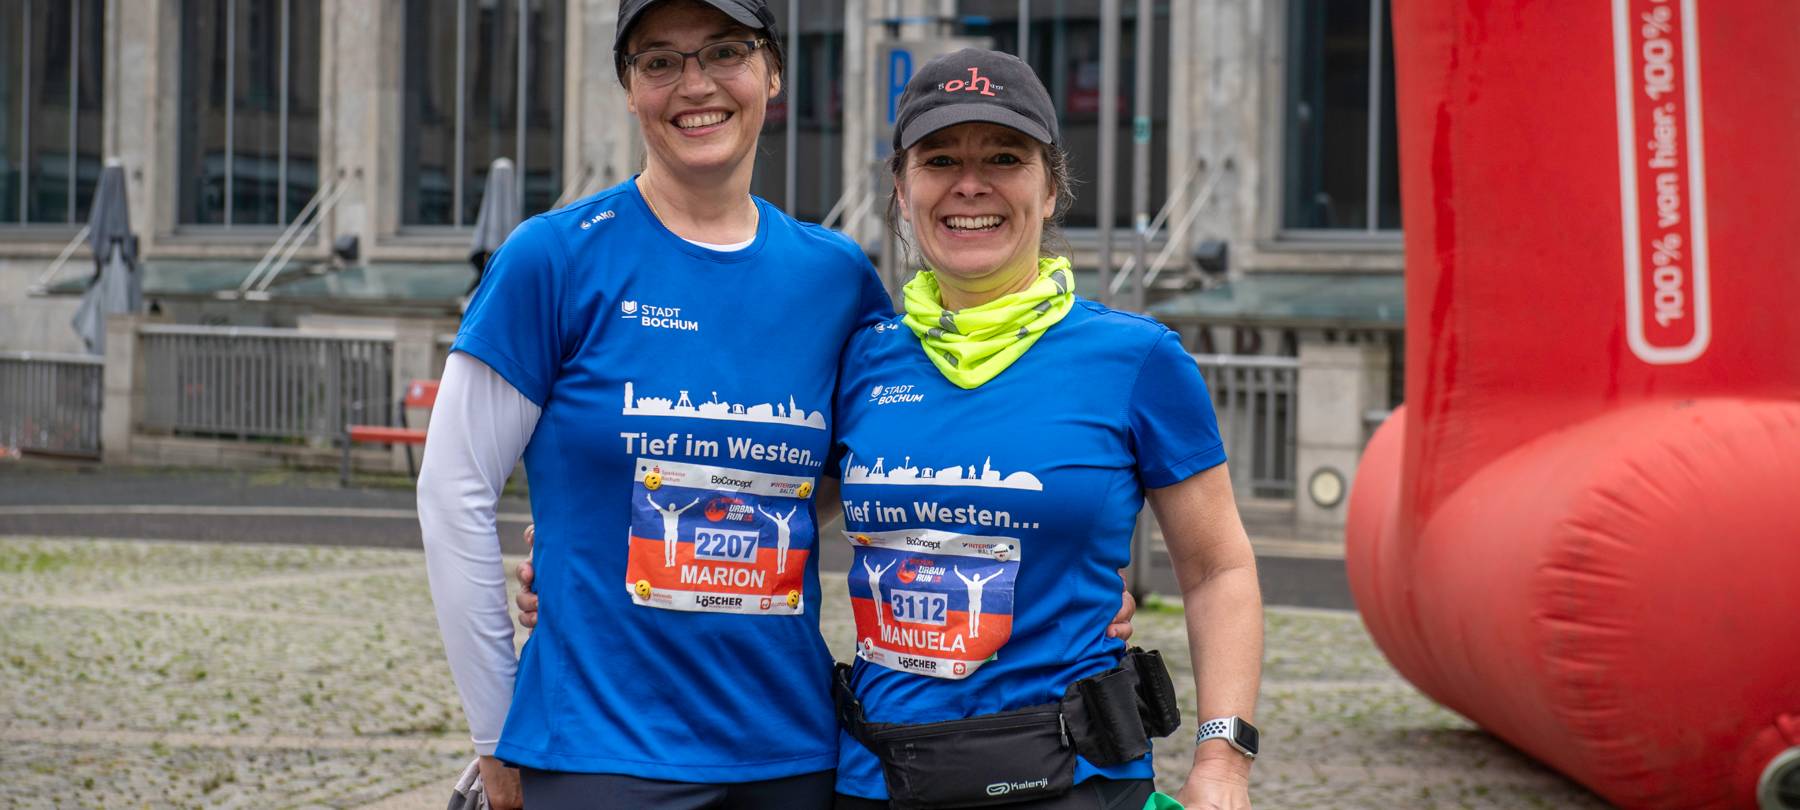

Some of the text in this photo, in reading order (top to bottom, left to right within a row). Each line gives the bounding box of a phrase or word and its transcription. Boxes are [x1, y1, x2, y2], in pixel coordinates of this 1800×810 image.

[1641, 5, 1684, 327] 100% von hier. 100%
[591, 210, 615, 224] JAKO
[641, 305, 681, 317] STADT
[641, 316, 698, 331] BOCHUM
[883, 385, 915, 396] STADT
[878, 394, 924, 405] BOCHUM
[620, 432, 821, 467] Tief im Westen...
[711, 475, 752, 488] BoConcept
[729, 504, 754, 514] URBAN
[875, 501, 907, 523] im
[913, 502, 1039, 529] Westen...
[726, 512, 744, 521] RUN
[696, 532, 757, 559] 2207
[906, 536, 941, 550] BoConcept
[680, 565, 765, 588] MARION
[918, 565, 946, 576] URBAN
[916, 573, 933, 583] RUN
[893, 594, 945, 622] 3112
[881, 624, 966, 653] MANUELA
[1010, 777, 1048, 790] Kalenji
